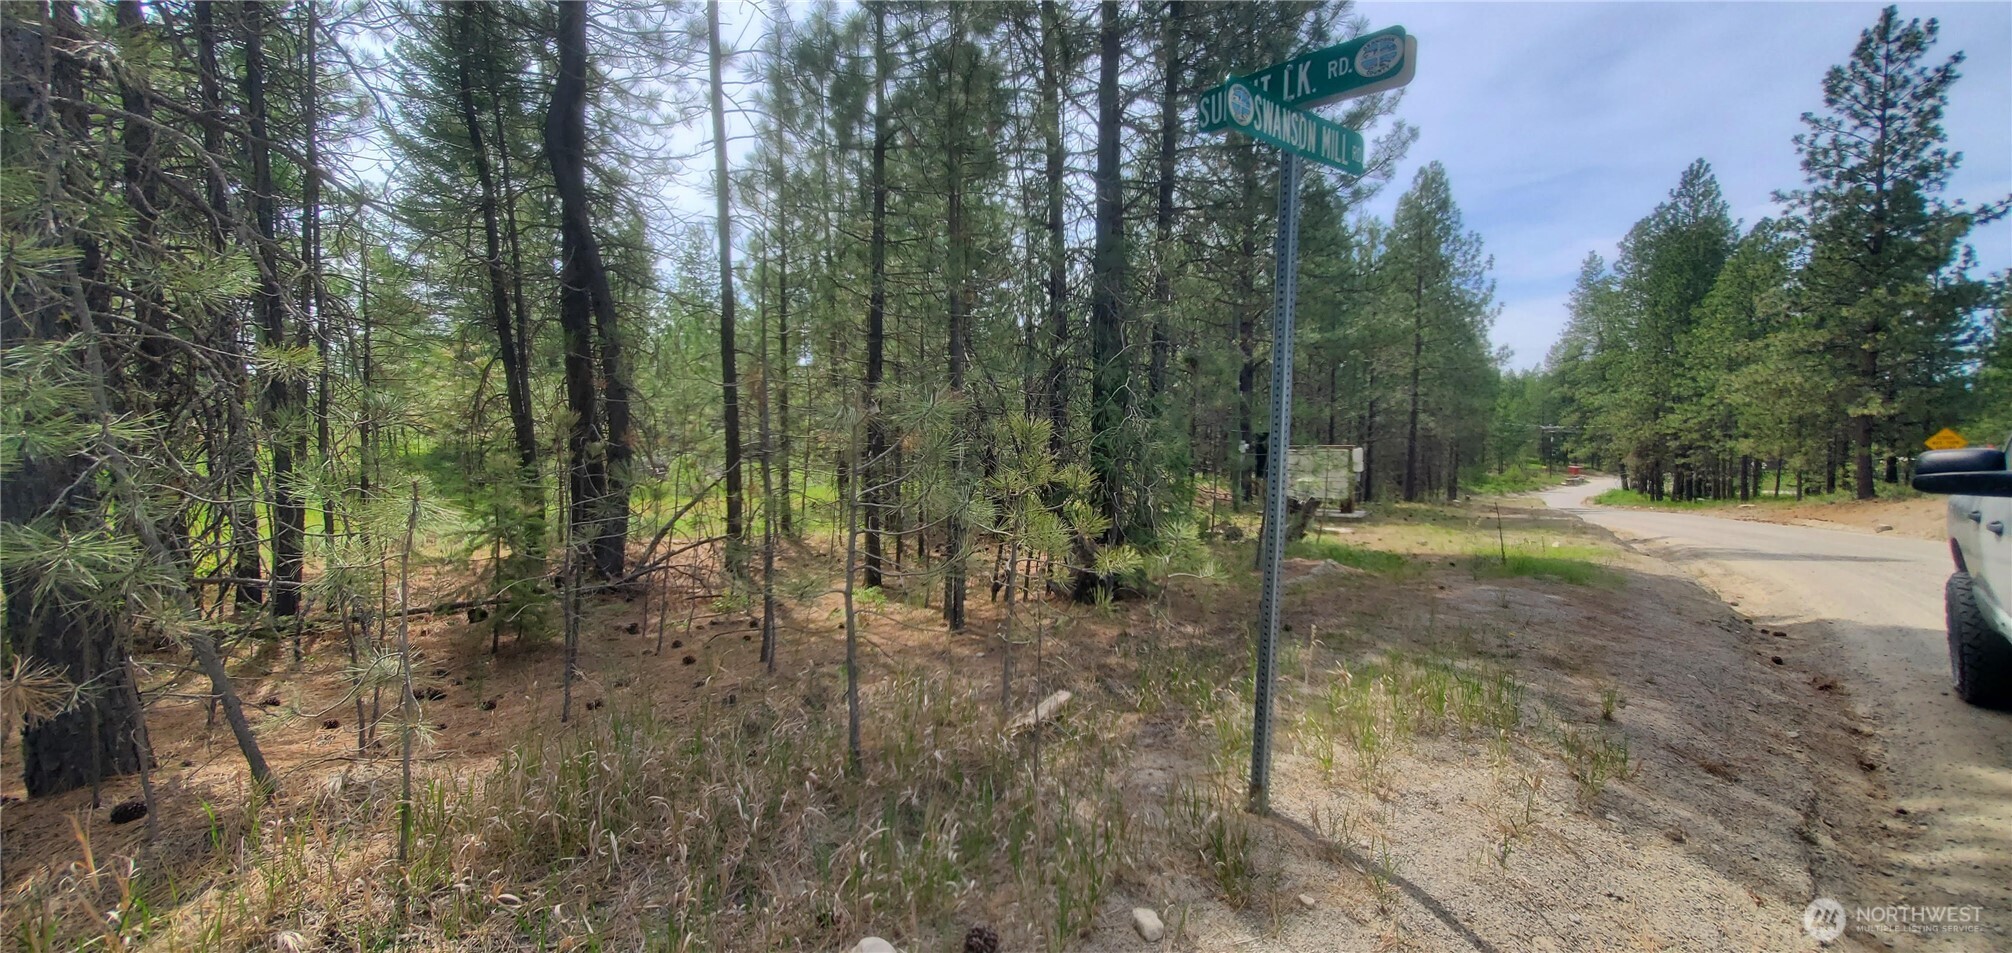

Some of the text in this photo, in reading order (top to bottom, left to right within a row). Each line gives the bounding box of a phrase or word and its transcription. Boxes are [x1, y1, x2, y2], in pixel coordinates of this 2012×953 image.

[1328, 57, 1353, 79] RD.
[1254, 94, 1317, 154] SWANSON
[1321, 125, 1349, 165] MILL
